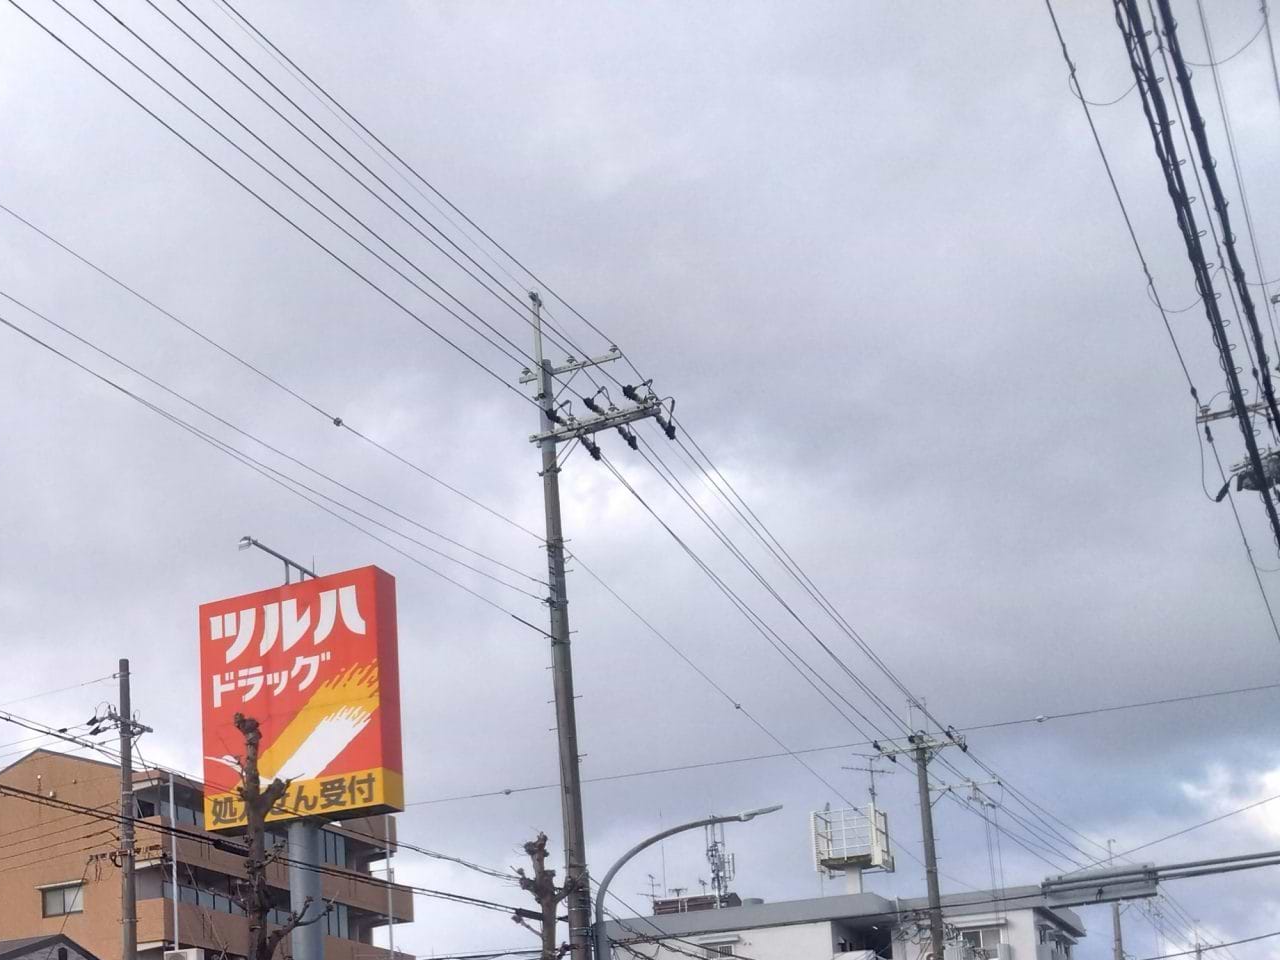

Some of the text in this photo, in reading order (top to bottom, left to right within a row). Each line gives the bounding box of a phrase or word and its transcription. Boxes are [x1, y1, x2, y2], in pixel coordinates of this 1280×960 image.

[209, 584, 366, 664] ツルハ
[213, 652, 331, 708] ドラッグ
